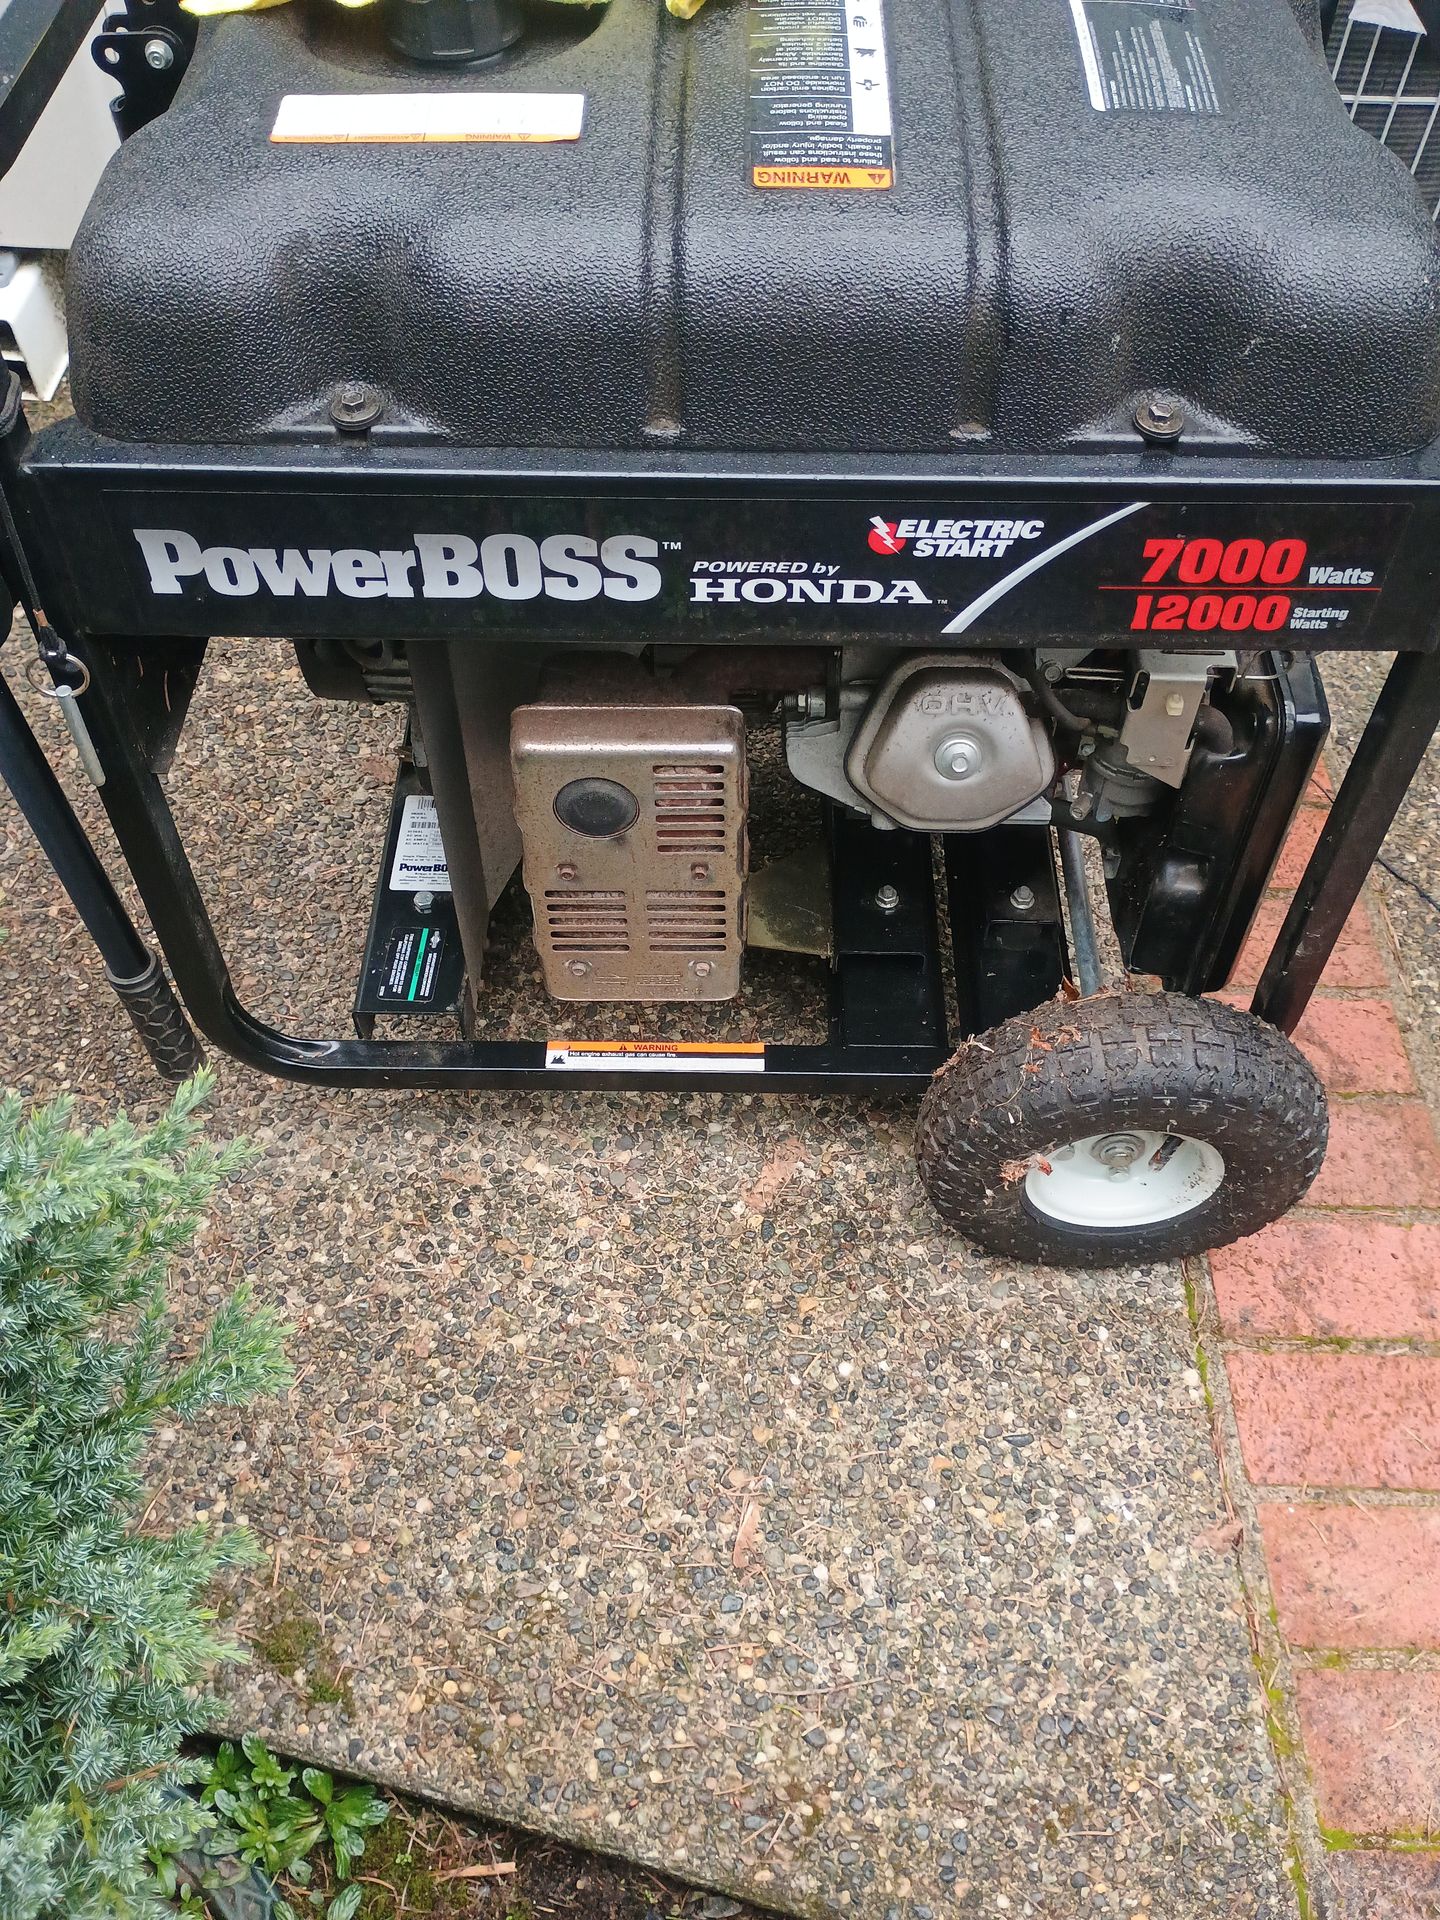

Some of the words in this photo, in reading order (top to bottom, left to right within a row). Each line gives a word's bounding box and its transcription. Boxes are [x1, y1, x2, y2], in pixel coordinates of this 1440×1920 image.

[757, 172, 850, 184] WARNING
[896, 519, 1045, 539] ELECTRIC
[912, 539, 1014, 557] START
[132, 528, 662, 602] PowerBOSS
[692, 560, 808, 574] POWERED
[811, 562, 840, 576] by
[1141, 538, 1308, 584] 7000
[1307, 566, 1374, 585] Watts
[689, 577, 934, 604] HONDA
[1130, 594, 1291, 631] 12000
[1292, 606, 1350, 620] Starting
[1289, 618, 1328, 630] Watts
[399, 863, 448, 872] PowerBO
